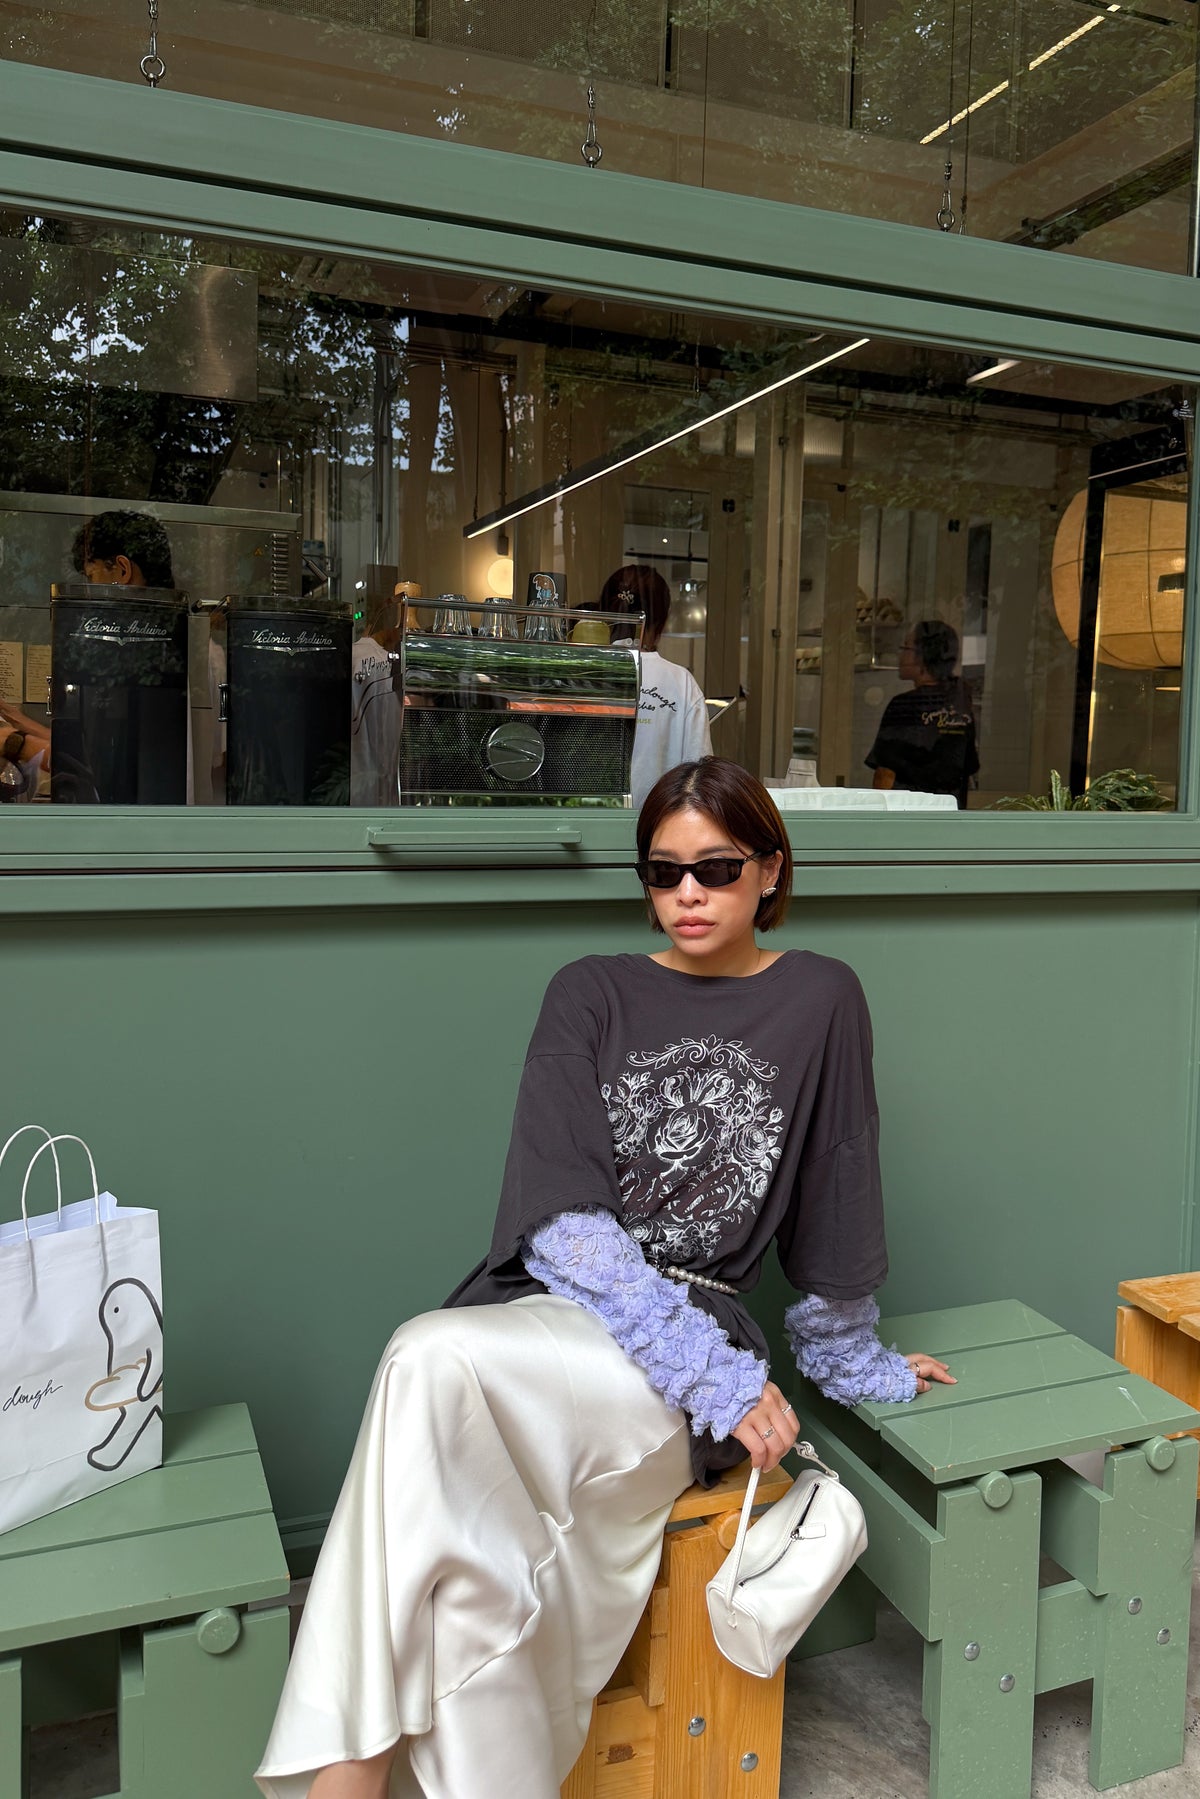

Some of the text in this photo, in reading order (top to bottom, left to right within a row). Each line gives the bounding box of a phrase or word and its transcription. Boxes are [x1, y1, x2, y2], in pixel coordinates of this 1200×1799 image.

[80, 617, 167, 636] Victoria Arduino
[252, 628, 333, 645] Victoria Arduino
[3, 1379, 64, 1412] dough
